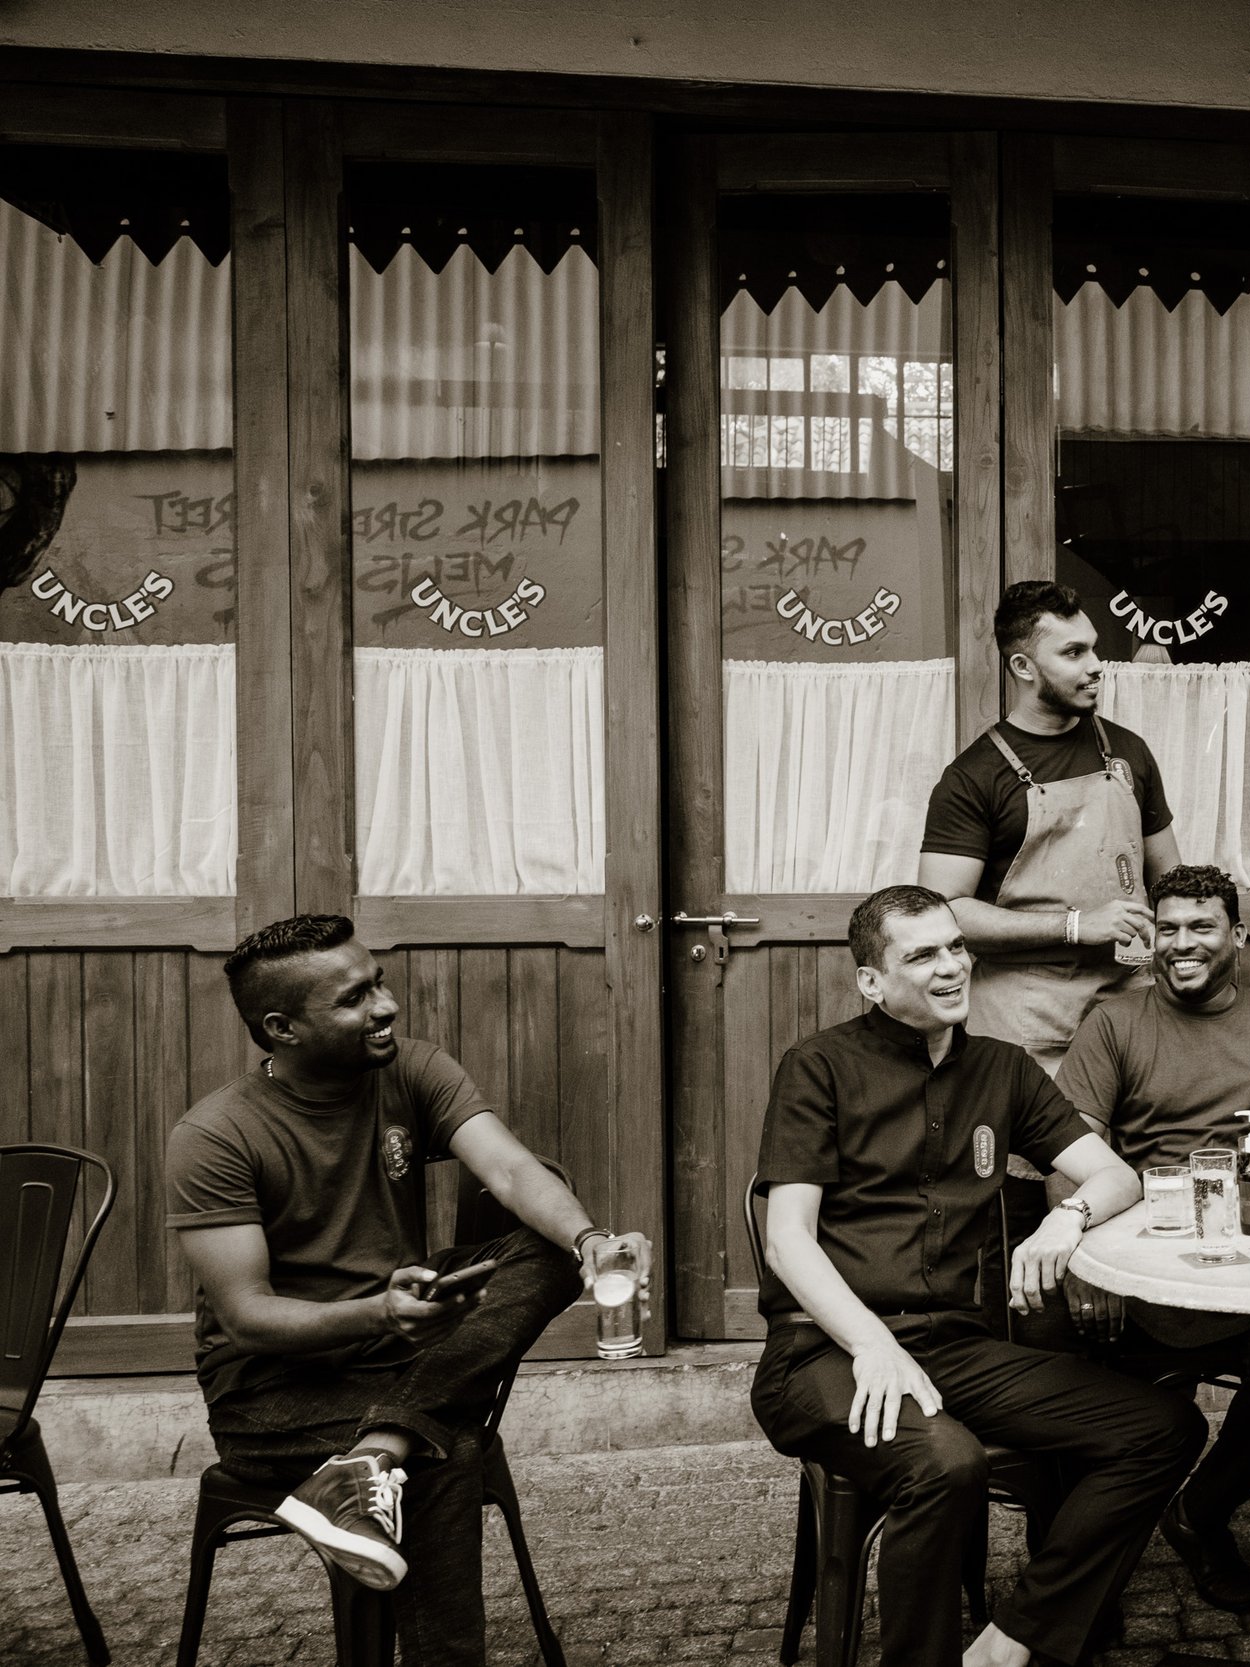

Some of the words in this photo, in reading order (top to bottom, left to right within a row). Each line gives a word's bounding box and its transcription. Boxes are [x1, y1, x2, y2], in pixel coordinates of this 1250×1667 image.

[31, 569, 174, 632] UNCLE'S
[411, 577, 545, 637] UNCLE'S
[776, 587, 901, 646] UNCLE'S
[1109, 589, 1229, 645] UNCLE'S
